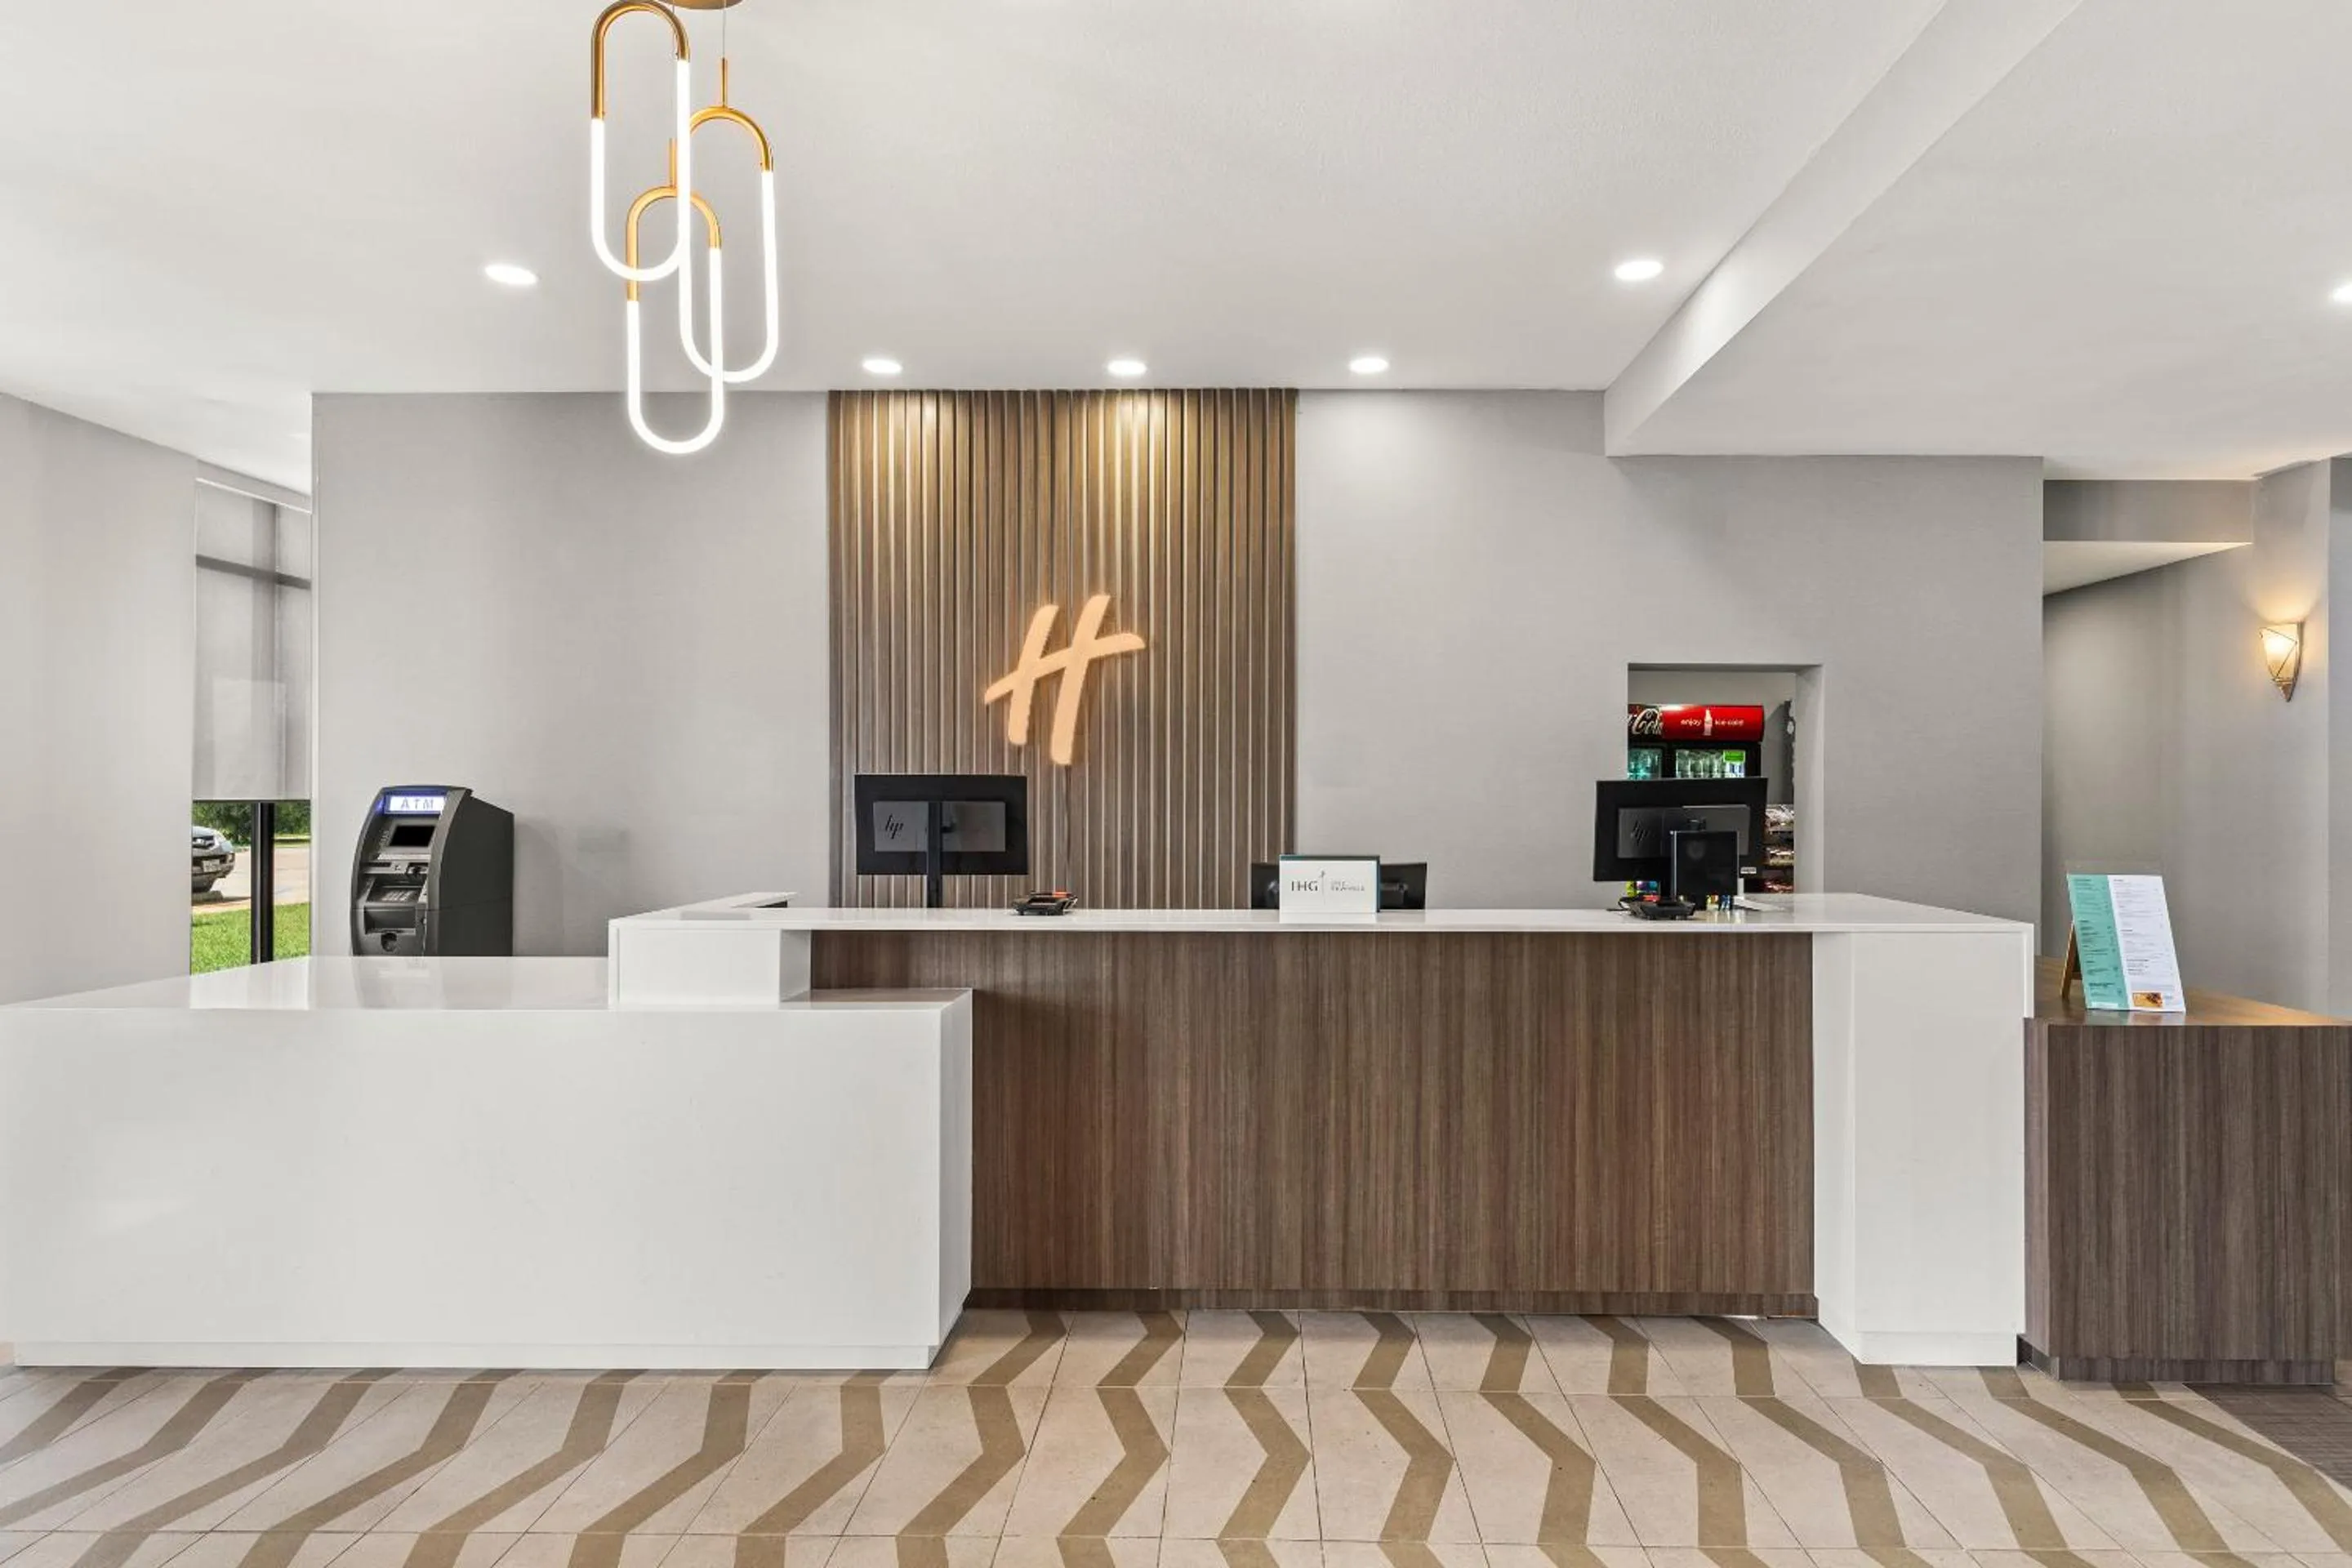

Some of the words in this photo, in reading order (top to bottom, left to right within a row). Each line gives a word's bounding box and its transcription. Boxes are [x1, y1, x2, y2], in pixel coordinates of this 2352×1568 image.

[984, 595, 1145, 765] H
[1680, 718, 1701, 727] enjoy
[400, 796, 434, 809] ATM
[885, 813, 903, 839] hp
[1291, 880, 1319, 892] IHG
